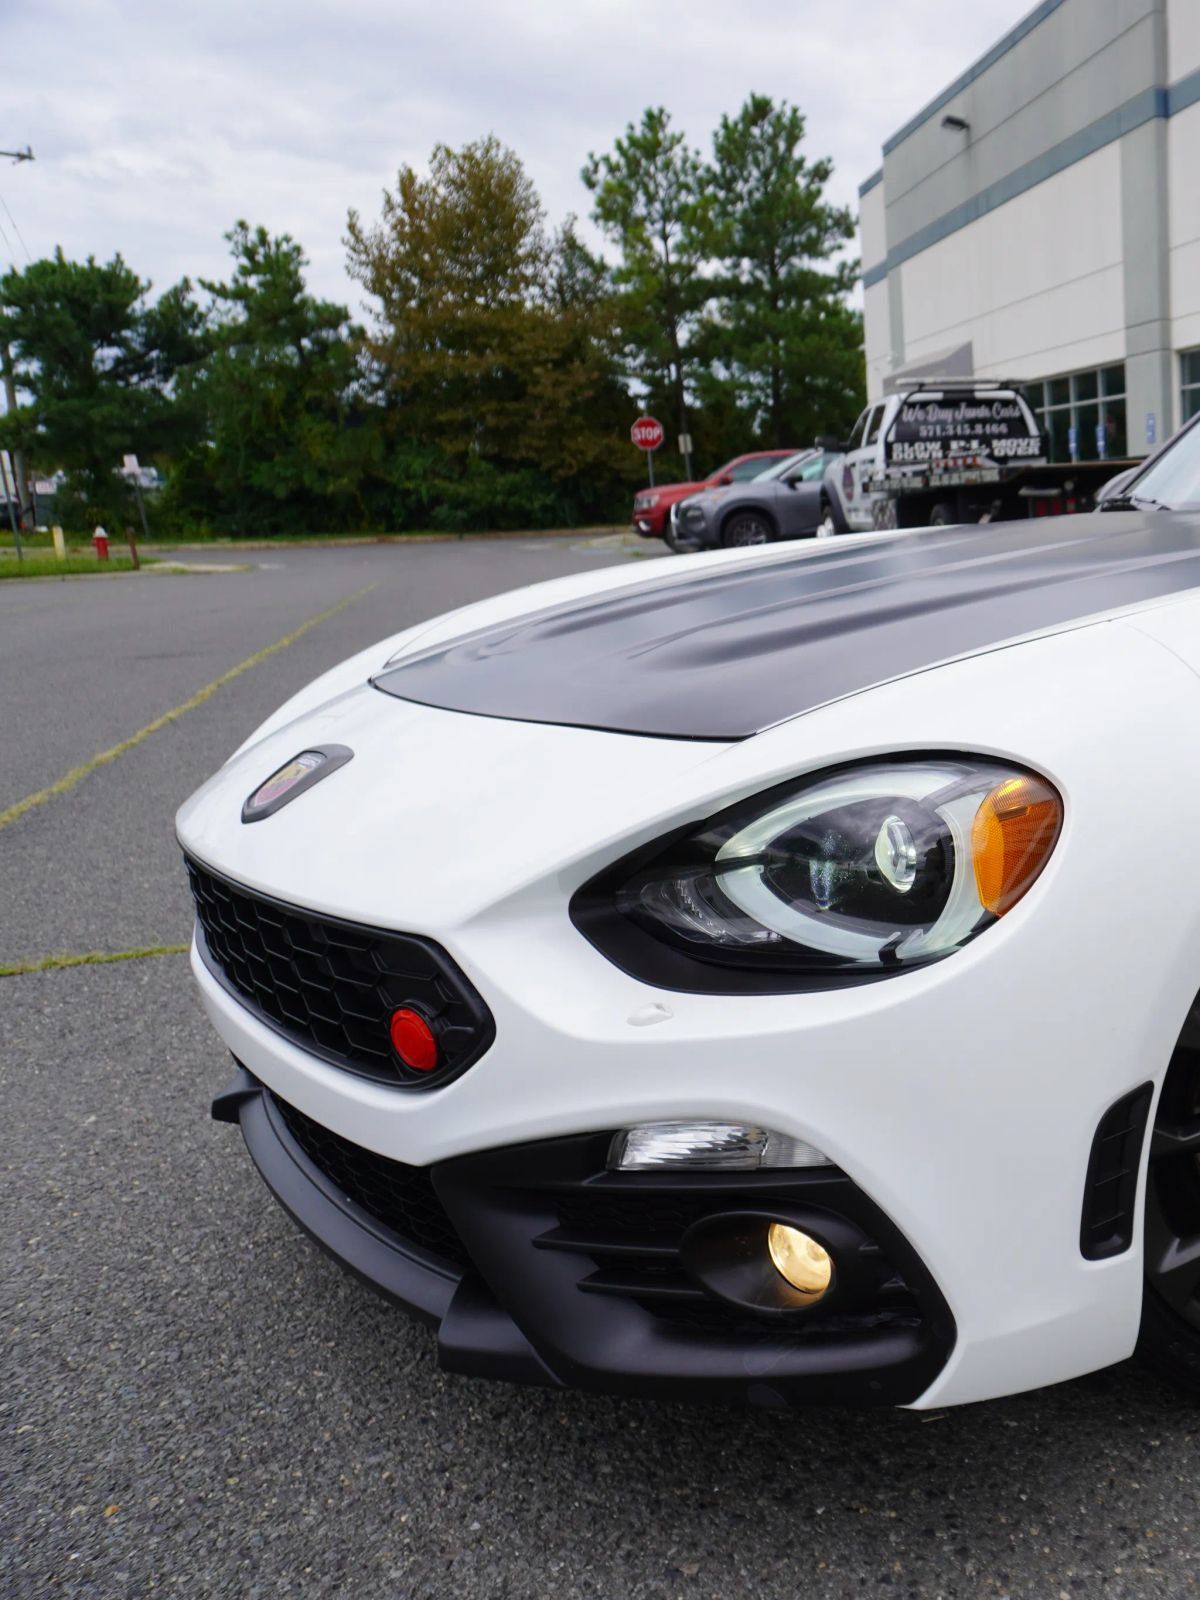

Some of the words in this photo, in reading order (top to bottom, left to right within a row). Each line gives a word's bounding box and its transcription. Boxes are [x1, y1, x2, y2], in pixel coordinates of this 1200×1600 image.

[902, 404, 925, 422] We
[927, 402, 953, 422] Buy
[992, 401, 1021, 419] Cars
[633, 426, 660, 442] STOP
